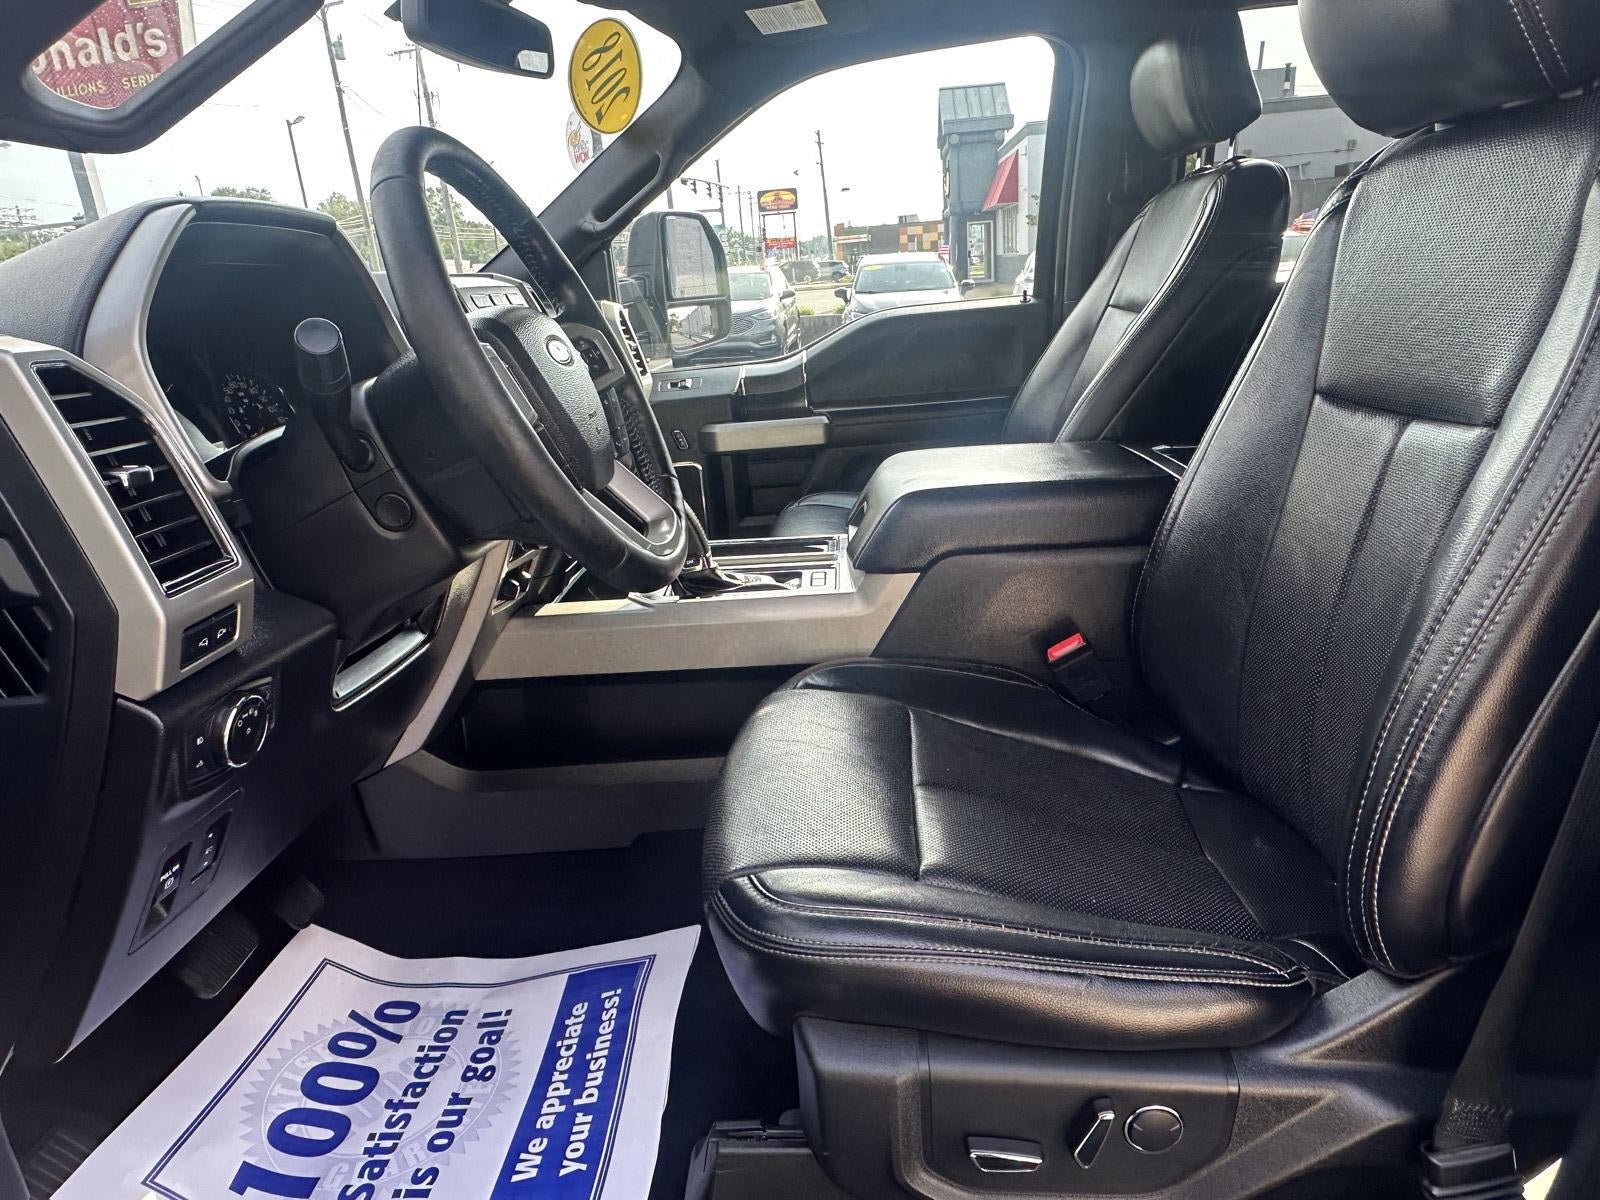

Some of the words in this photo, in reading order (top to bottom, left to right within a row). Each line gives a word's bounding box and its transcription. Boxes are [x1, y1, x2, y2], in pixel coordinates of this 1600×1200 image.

[55, 82, 106, 97] ILLIONS
[121, 73, 160, 89] SERV
[229, 1000, 421, 1198] 100%
[338, 1010, 469, 1200] Satisfaction
[391, 1166, 440, 1199] is
[427, 1092, 473, 1152] our
[461, 1008, 513, 1083] goal!
[510, 1137, 548, 1183] We
[536, 1001, 588, 1130] appreciate
[573, 988, 622, 1106] business!
[559, 1112, 593, 1178] your
